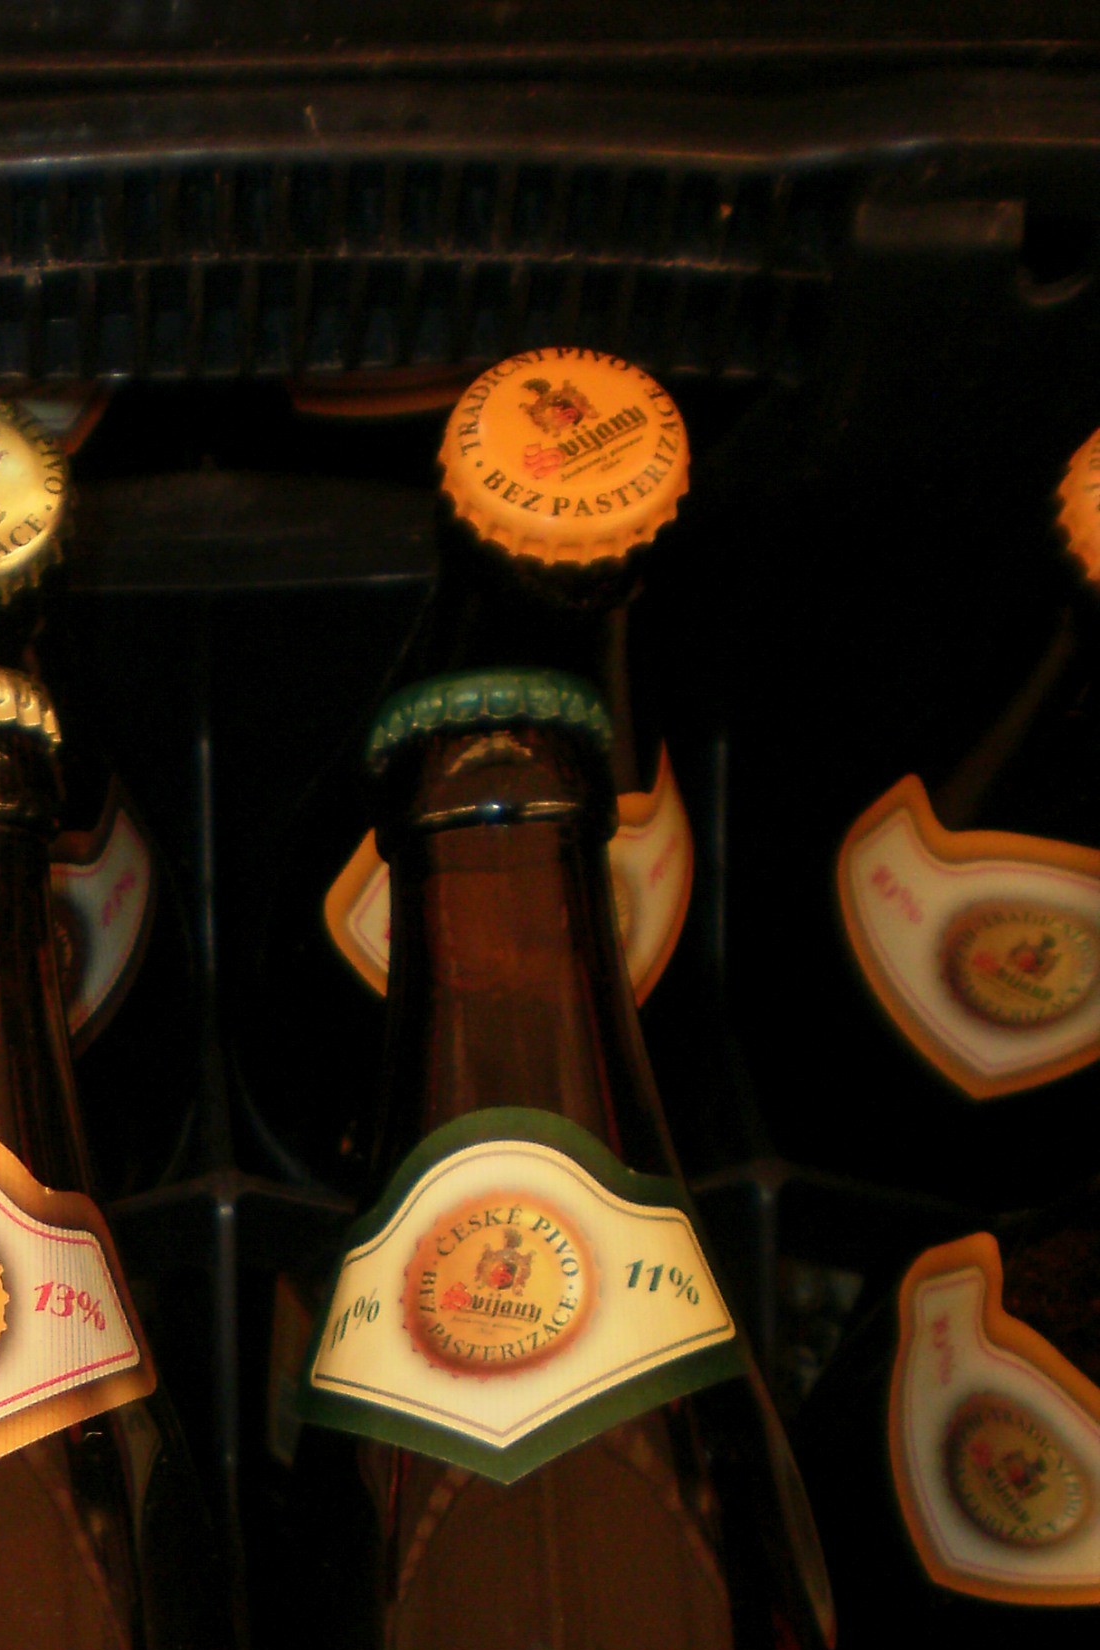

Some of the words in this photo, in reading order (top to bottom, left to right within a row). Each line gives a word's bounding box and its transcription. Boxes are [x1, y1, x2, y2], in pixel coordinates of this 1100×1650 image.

[481, 467, 545, 514] BEZ
[551, 384, 680, 518] PASTERIZACE
[523, 404, 649, 480] Svijany
[435, 1203, 524, 1257] ČESKÉ
[530, 1216, 581, 1278] PIVO
[32, 1280, 108, 1332] 13%
[441, 1281, 544, 1323] Svijany
[624, 1257, 701, 1307] 11%
[426, 1295, 579, 1364] PASTERIZACE
